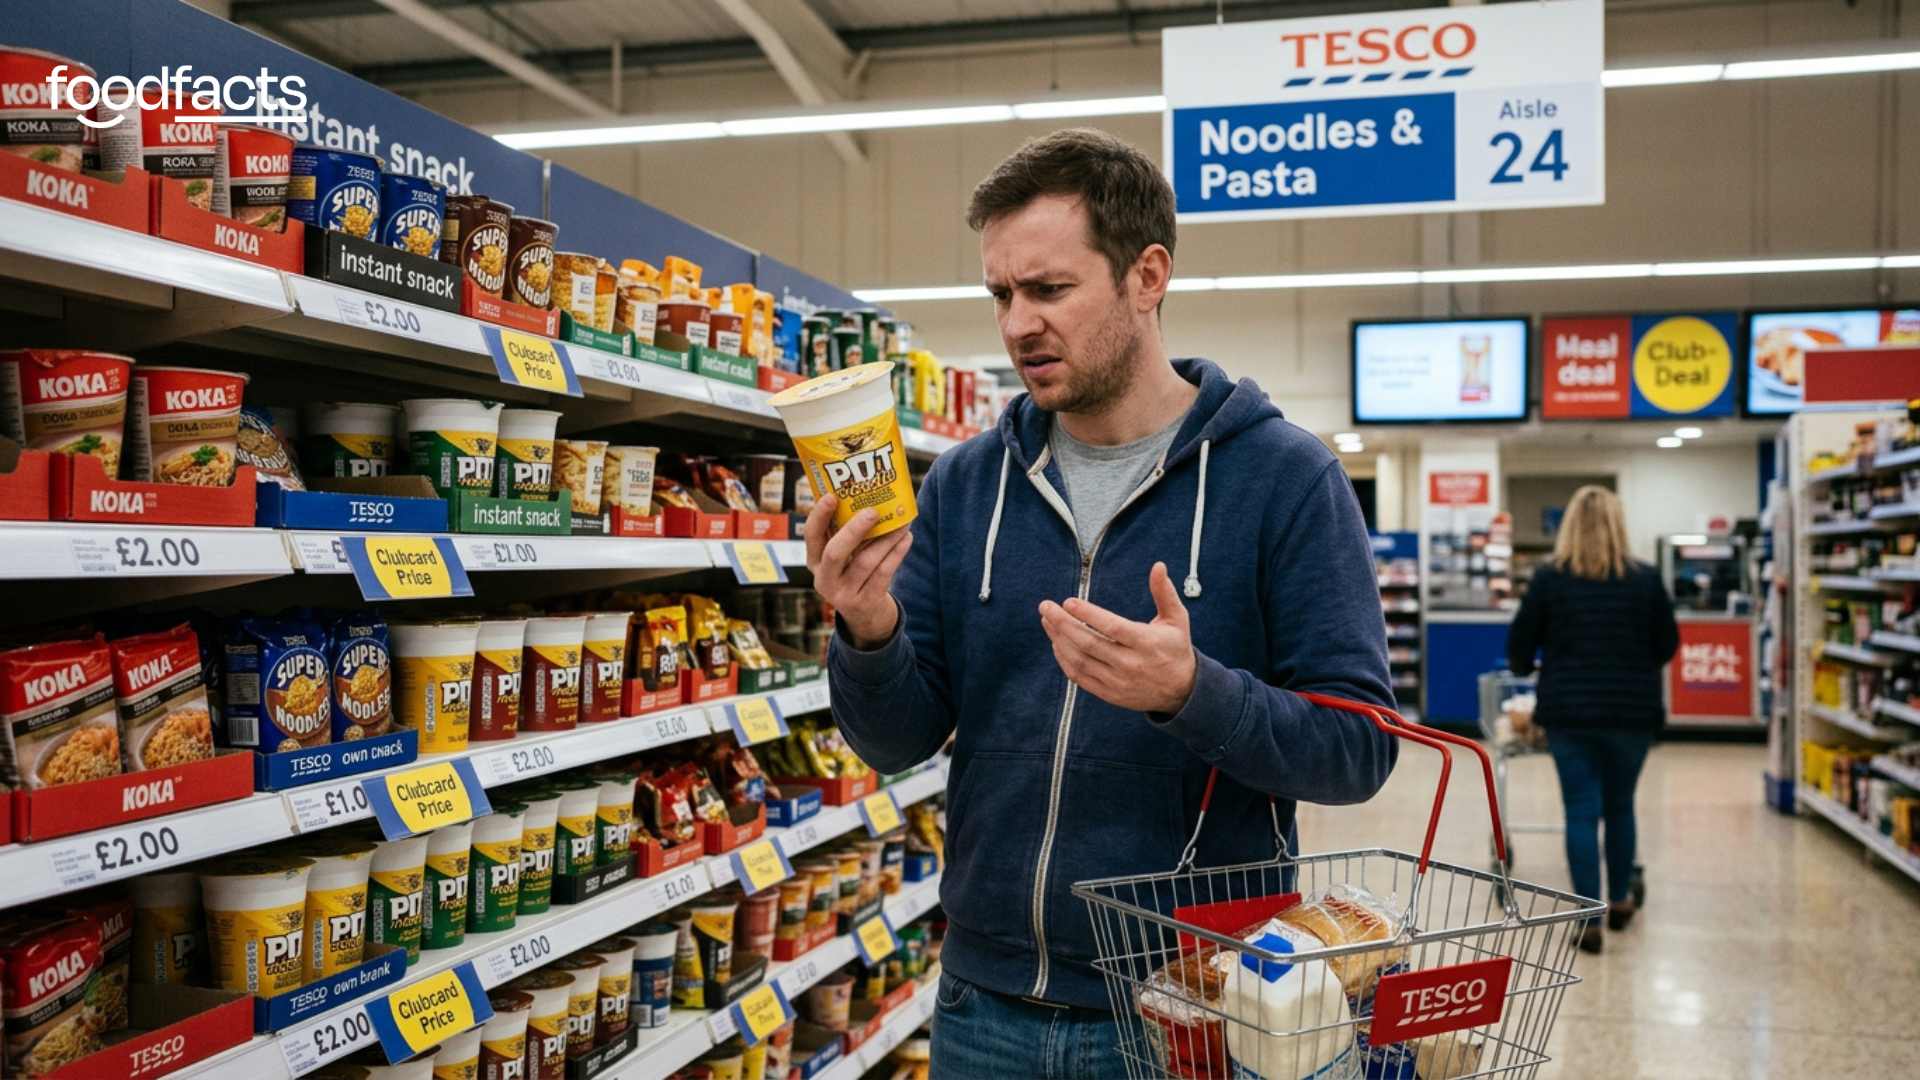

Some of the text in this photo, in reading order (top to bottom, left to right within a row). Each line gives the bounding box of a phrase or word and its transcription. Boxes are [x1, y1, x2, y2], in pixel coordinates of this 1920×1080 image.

[1281, 22, 1477, 69] TESCO
[1499, 99, 1558, 120] Aisle
[7, 121, 50, 133] KOKA
[159, 123, 214, 144] KOKA
[1200, 107, 1423, 156] Noodles &
[1488, 129, 1569, 185] 24
[27, 169, 89, 209] KOKA
[1200, 161, 1318, 201] Pasta
[214, 224, 260, 257] KOKA
[341, 245, 403, 285] instant
[407, 267, 456, 300] snack
[365, 300, 421, 334] £2.00
[1555, 334, 1618, 359] Meal
[38, 372, 108, 399] KOKA
[1558, 360, 1616, 387] deal
[1655, 366, 1710, 387] Deal
[165, 387, 227, 411] KOKA
[90, 490, 145, 514] KOKA
[350, 502, 394, 517] TESCO
[474, 504, 523, 526] instant
[526, 509, 561, 527] snack
[115, 537, 200, 567] £2.00
[396, 569, 433, 586] Price
[1681, 643, 1741, 664] MEAL
[24, 663, 87, 705] KOKA
[128, 654, 173, 691] KOKA
[1681, 664, 1741, 683] DEAL
[290, 753, 331, 772] TESCO
[342, 747, 368, 765] own
[122, 778, 175, 811] KOKA
[324, 785, 369, 817] £1.0
[417, 798, 454, 819] Price
[95, 826, 179, 871] £2.00
[510, 934, 551, 968] £2.00
[29, 950, 86, 1000] KOKA
[290, 986, 329, 1010] TESCO
[398, 980, 459, 1020] Clubcard
[1400, 977, 1488, 1015] TESCO
[313, 1011, 371, 1056] £2.00
[419, 1008, 455, 1035] Price
[130, 1034, 185, 1069] TESCO
